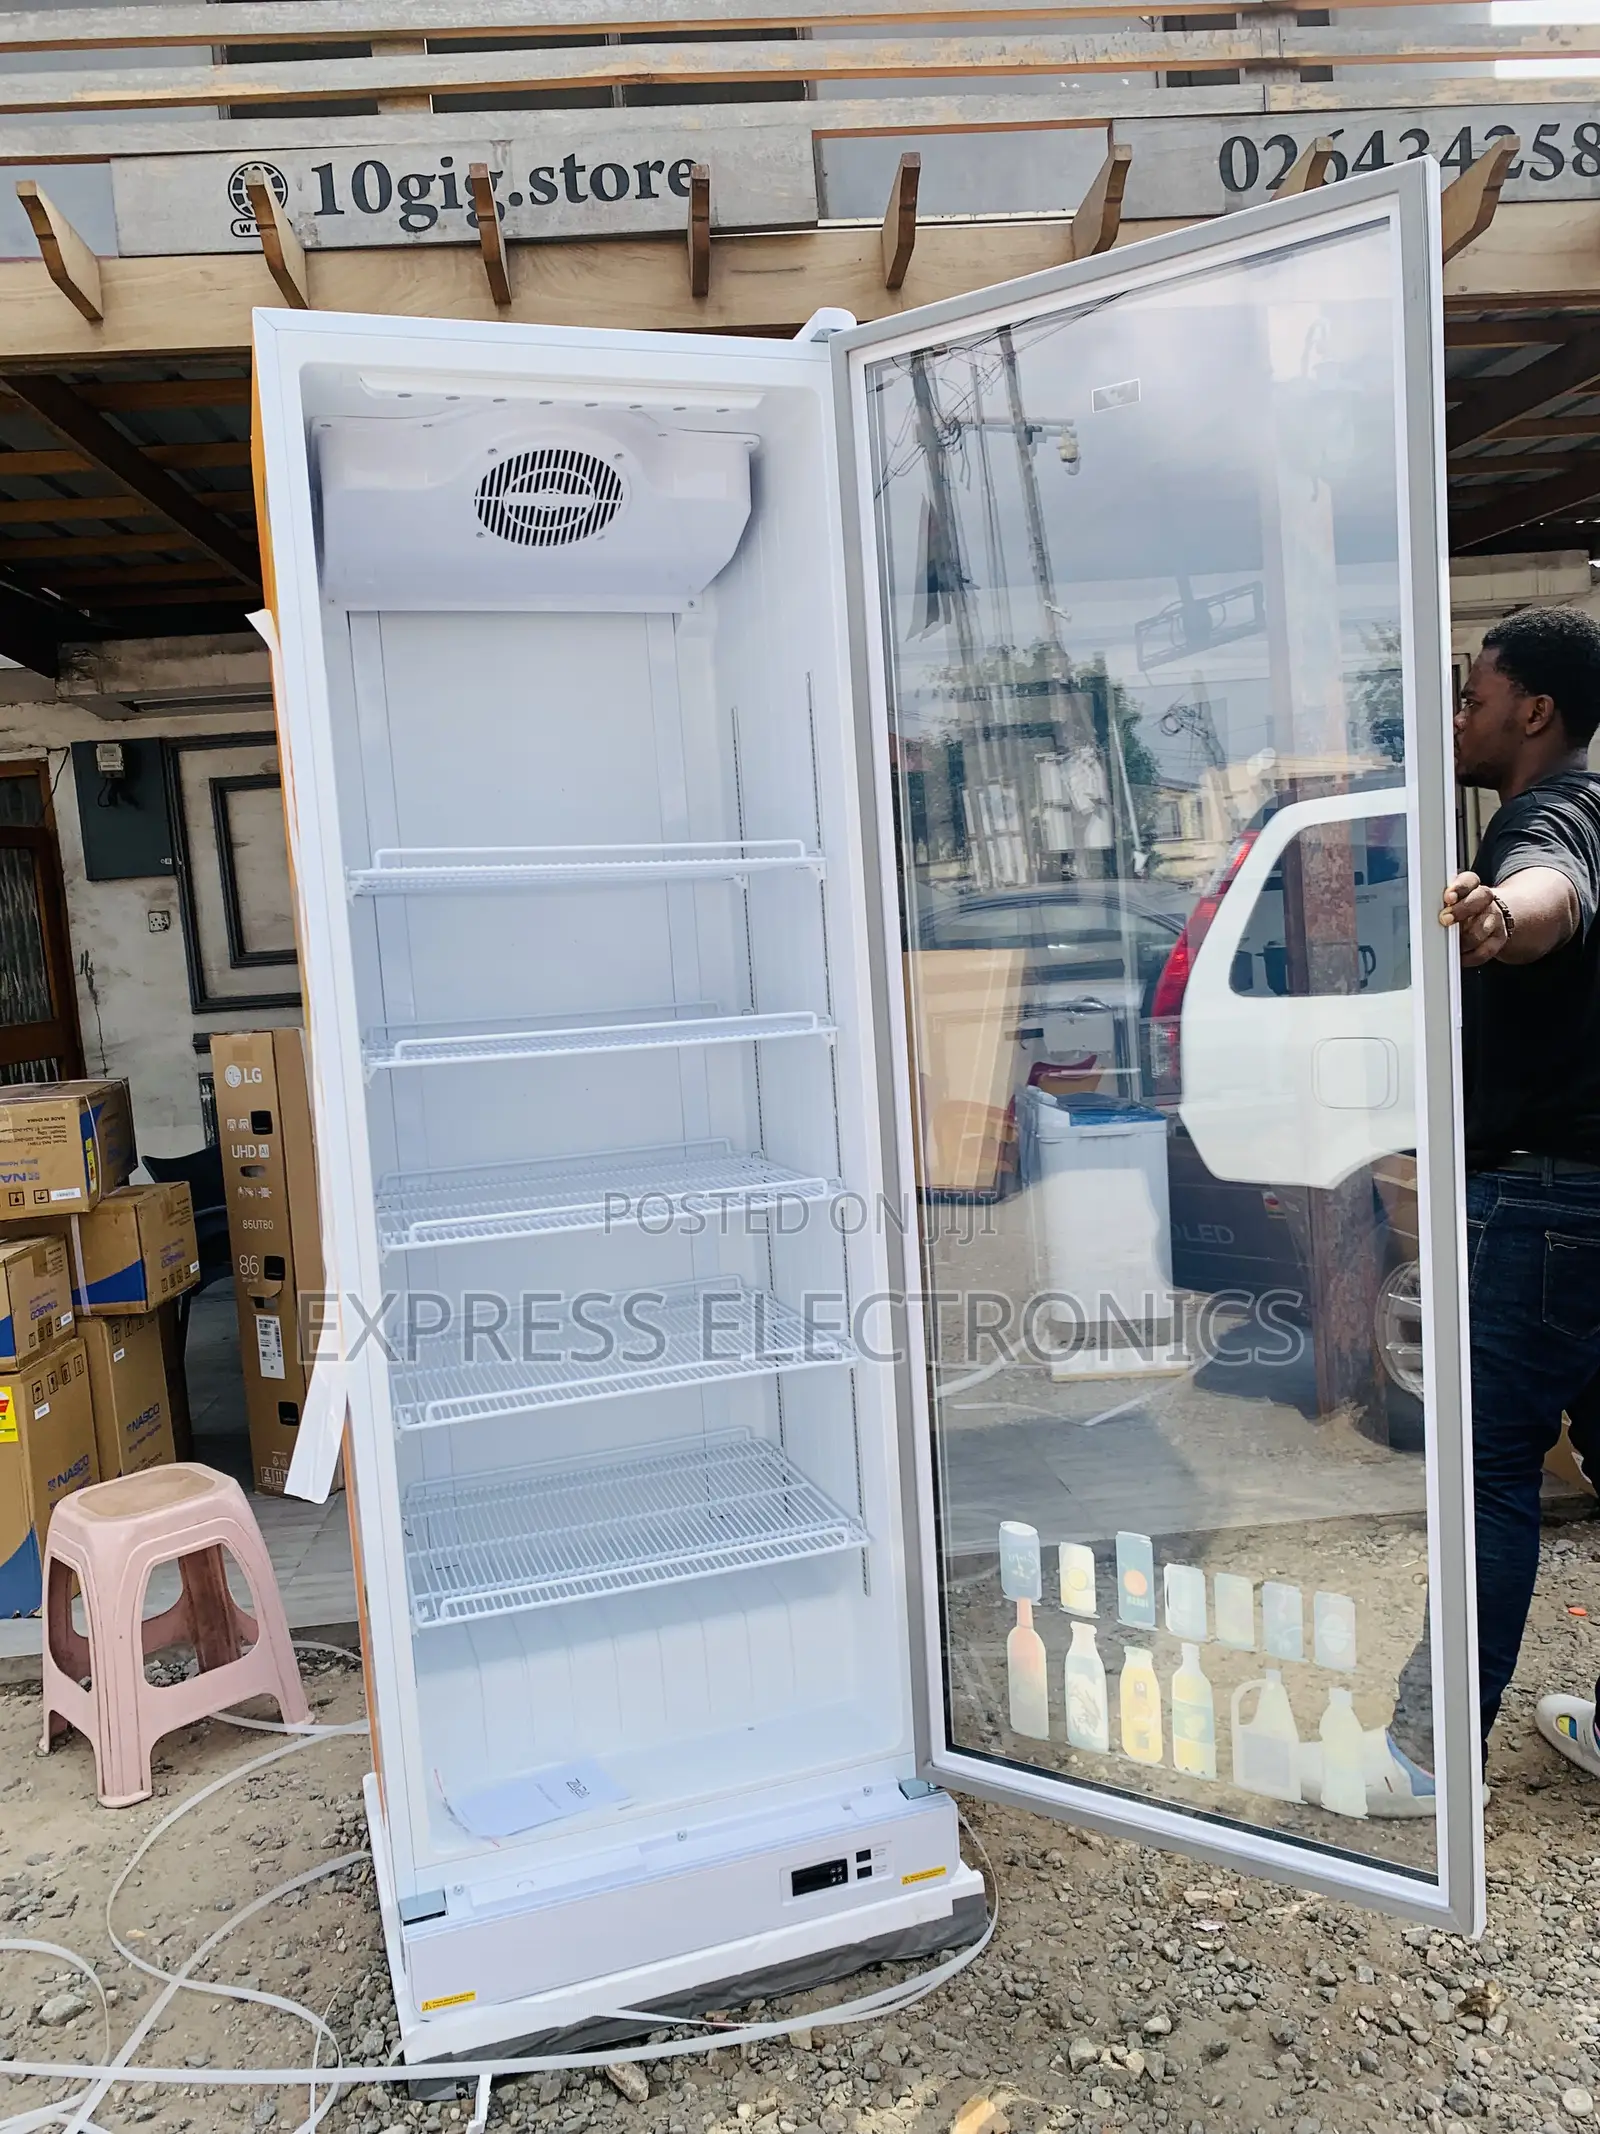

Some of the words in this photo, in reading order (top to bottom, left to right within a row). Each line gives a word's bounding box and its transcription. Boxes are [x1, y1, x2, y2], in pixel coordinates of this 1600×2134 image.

[311, 153, 693, 233] 10gig.store
[243, 1067, 263, 1083] LG
[231, 1144, 257, 1158] UHD
[239, 1254, 260, 1275] 86
[132, 1403, 160, 1432] NASCO
[57, 1454, 90, 1487] NASCO
